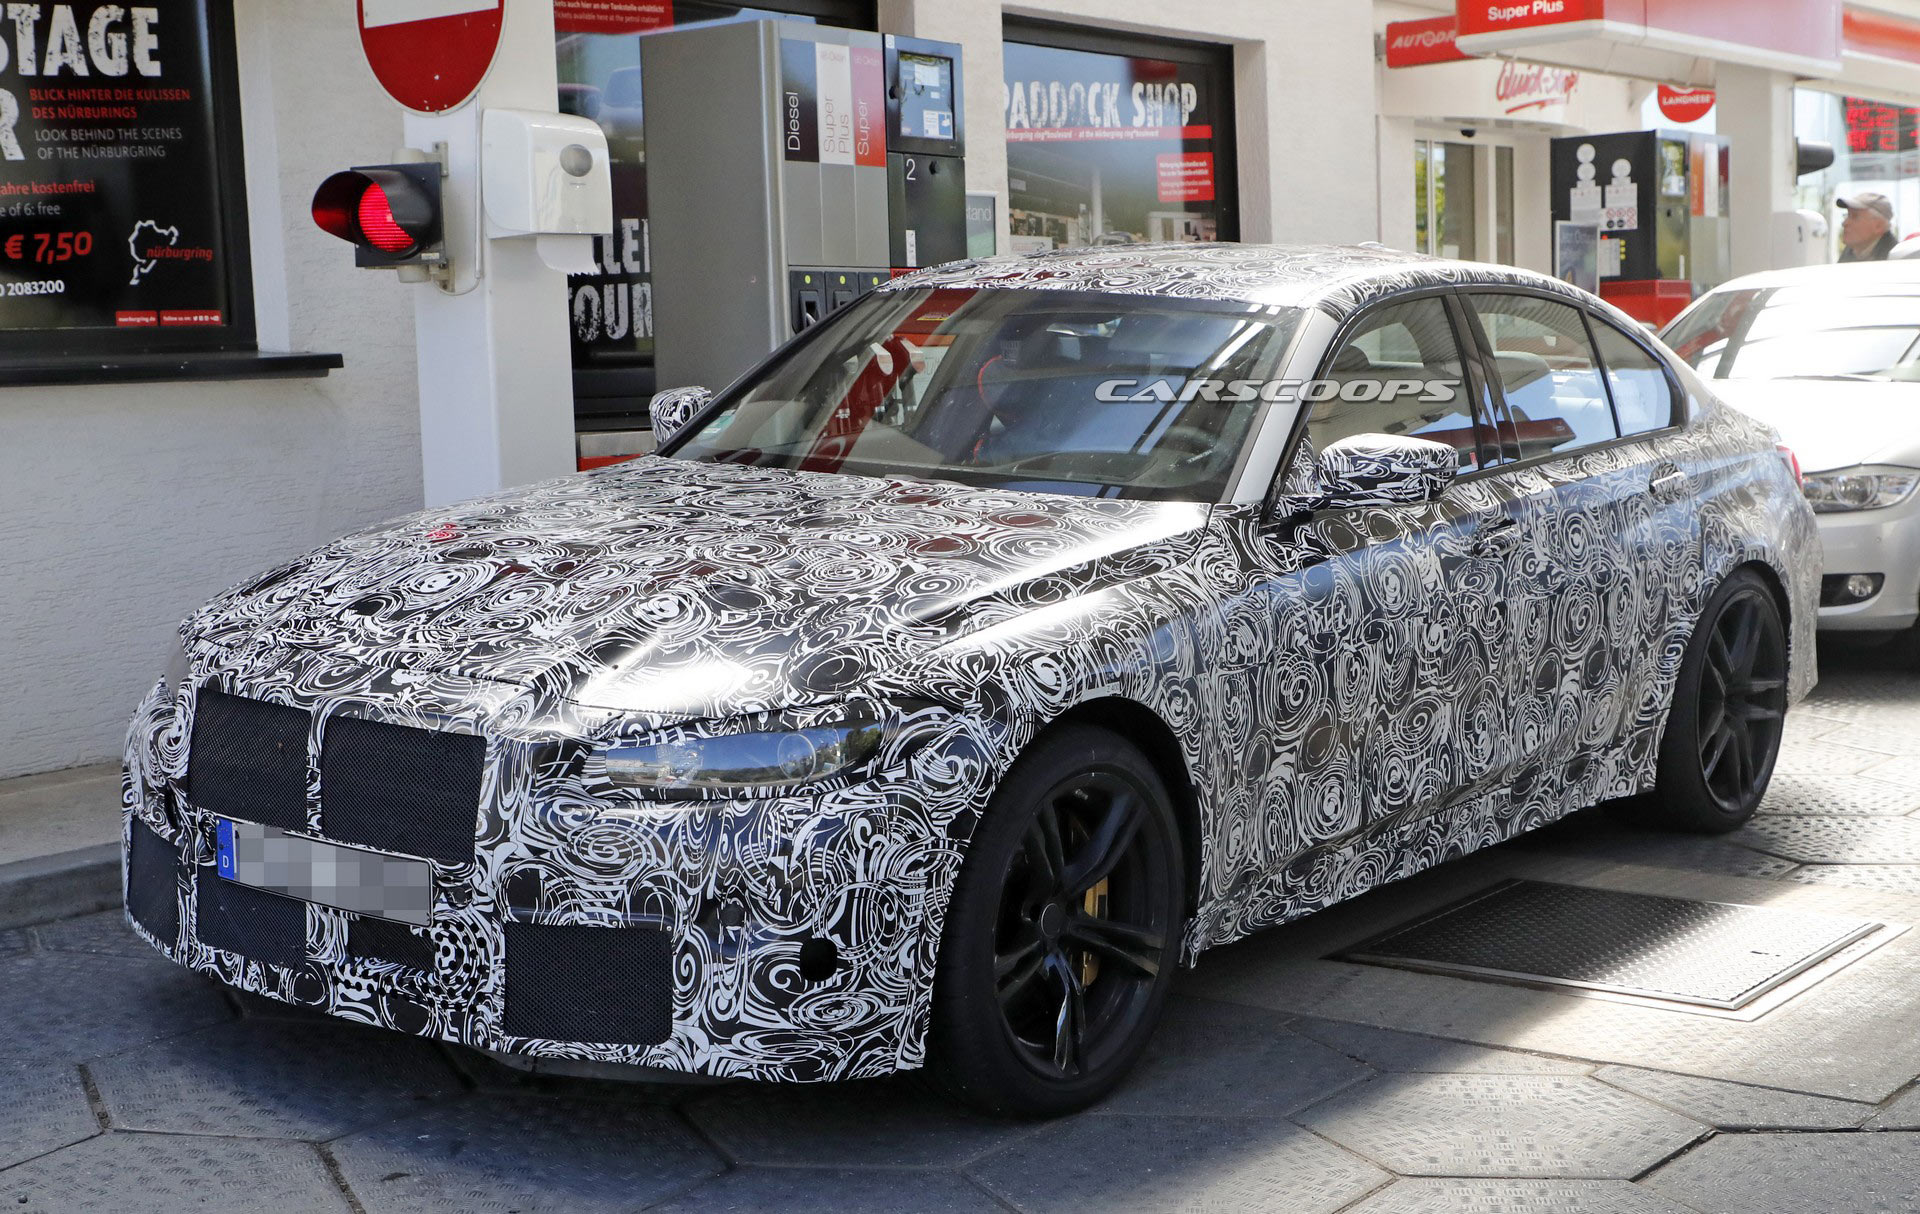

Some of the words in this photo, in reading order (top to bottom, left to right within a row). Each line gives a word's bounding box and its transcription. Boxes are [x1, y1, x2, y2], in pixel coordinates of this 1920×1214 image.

[1488, 4, 1530, 21] Super
[1532, 0, 1564, 15] Plus
[0, 2, 162, 77] TAGE
[29, 88, 65, 101] BLICK
[68, 88, 112, 101] HINTER
[114, 88, 134, 100] DIE
[136, 88, 191, 100] KULISSEN
[1132, 82, 1198, 128] SHOP
[32, 106, 56, 119] DES
[785, 91, 801, 151] Diesel
[35, 128, 68, 141] LOOK
[70, 128, 115, 141] BEHIND
[117, 127, 139, 140] THE
[141, 127, 183, 140] SCENES
[823, 96, 837, 153] Super
[838, 114, 850, 154] Plus
[857, 98, 871, 156] Super
[37, 147, 54, 159] OF
[56, 147, 79, 159] THE
[82, 144, 166, 159] NÜRBURGRING
[905, 158, 917, 182] 2
[0, 181, 29, 195] ahre
[31, 180, 95, 194] kostenfrei
[8, 201, 21, 217] of
[23, 202, 35, 217] 6:
[37, 201, 61, 216] free
[4, 234, 24, 260] €
[34, 231, 93, 265] 7,50
[146, 245, 214, 263] nürburgring
[6, 279, 65, 296] 2083200
[569, 282, 654, 343] OUR
[222, 854, 230, 868] D
